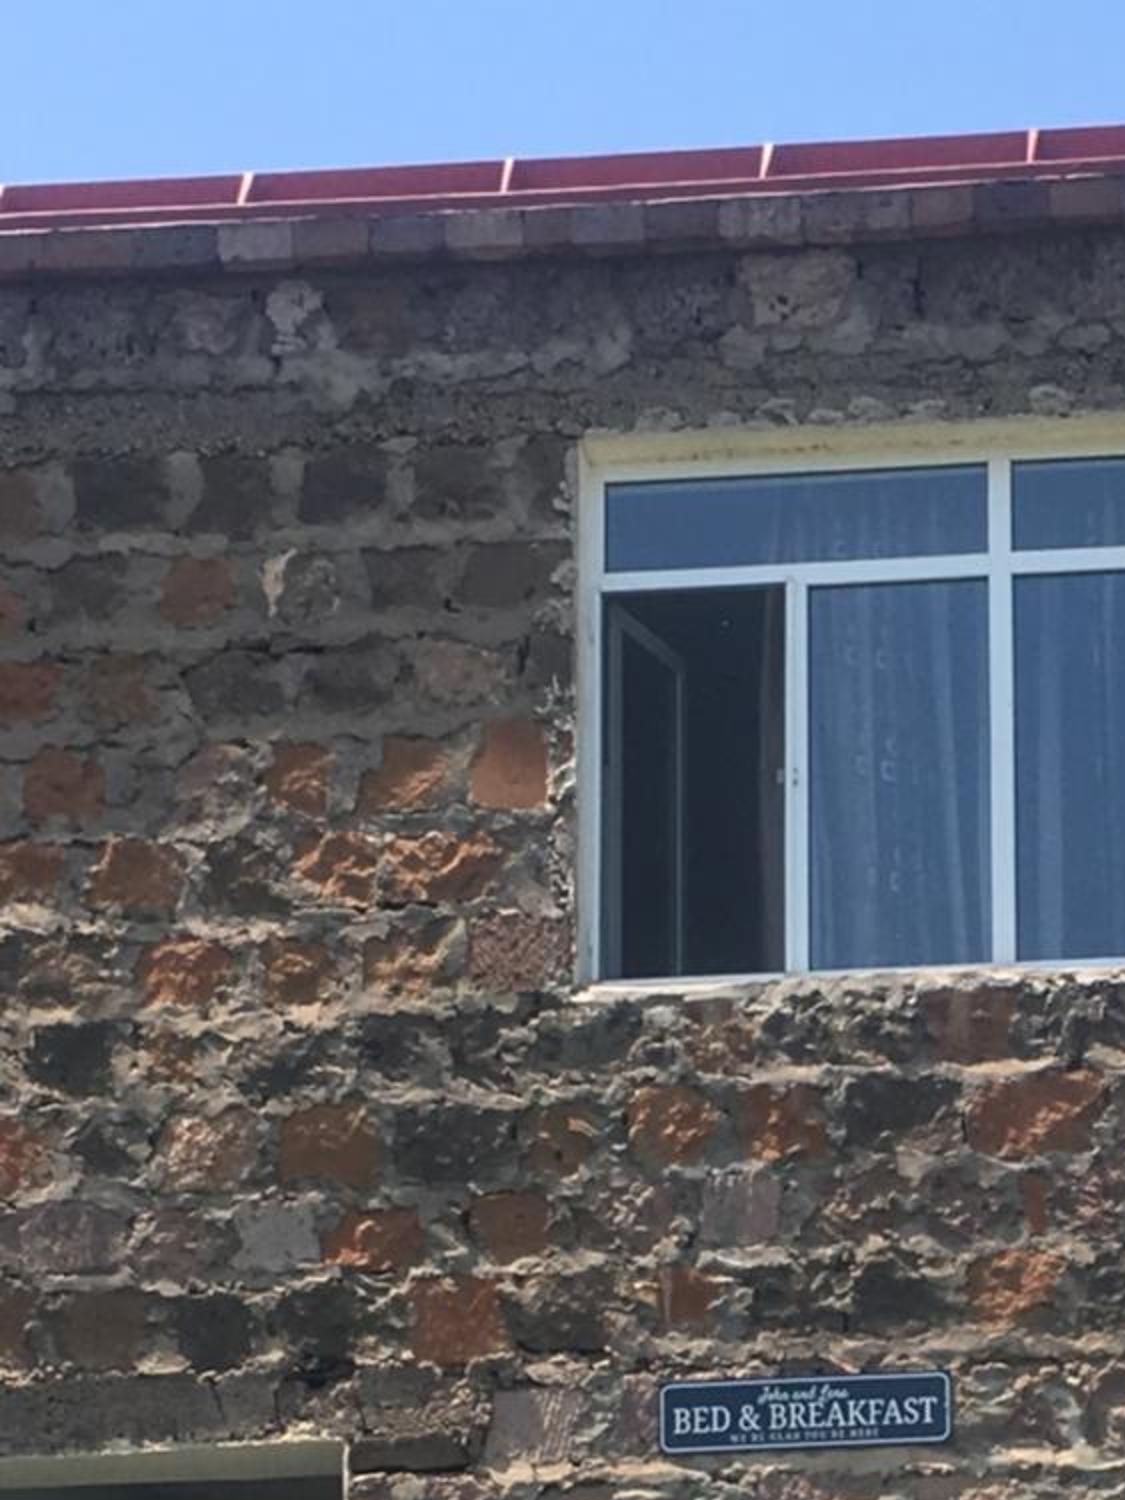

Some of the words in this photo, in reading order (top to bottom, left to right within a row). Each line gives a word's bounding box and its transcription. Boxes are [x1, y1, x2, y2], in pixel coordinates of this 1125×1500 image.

[673, 1405, 731, 1435] BED
[738, 1403, 761, 1431] &
[769, 1397, 938, 1431] BREAKFAST
